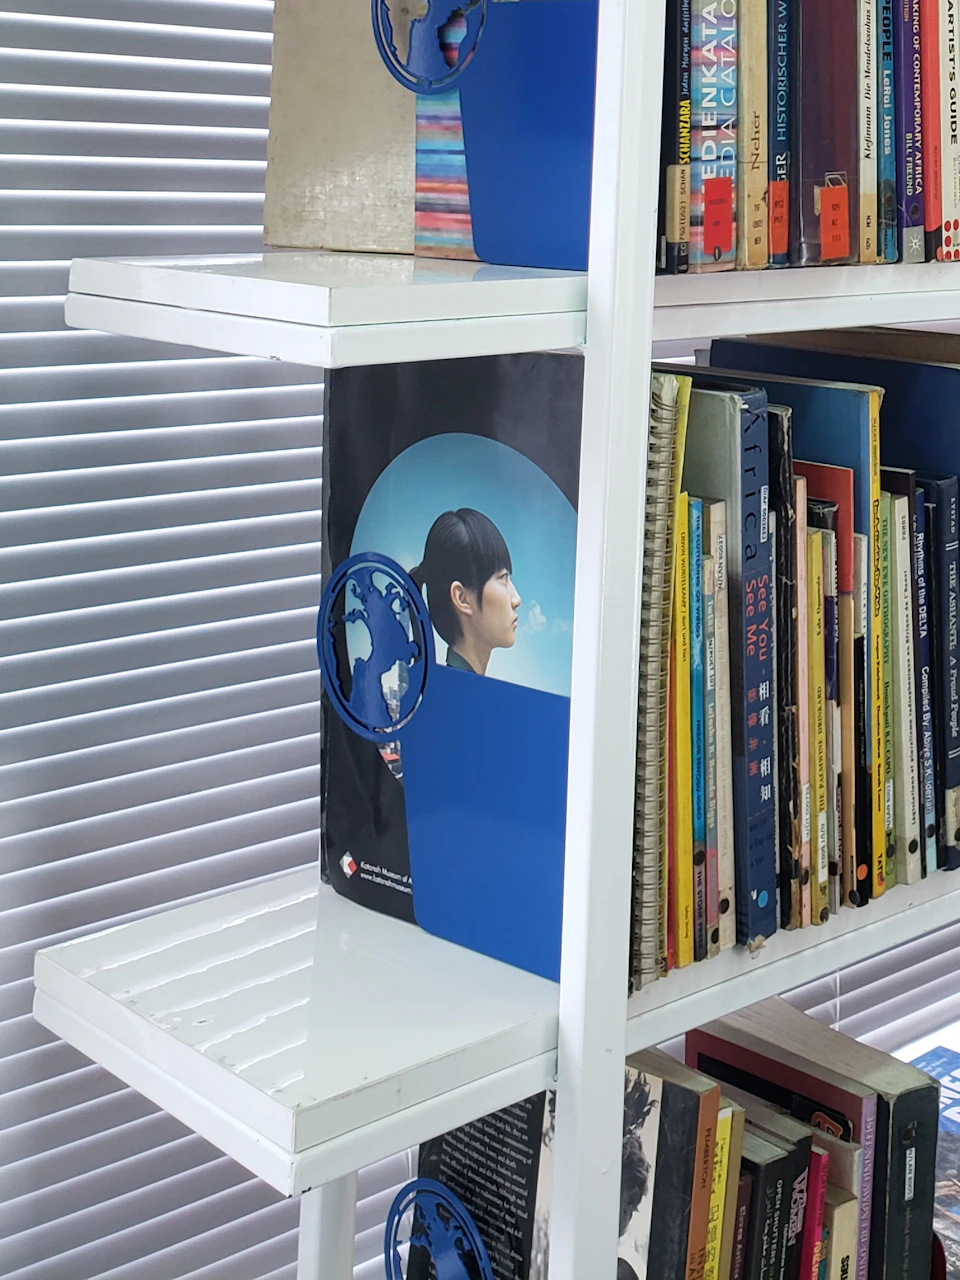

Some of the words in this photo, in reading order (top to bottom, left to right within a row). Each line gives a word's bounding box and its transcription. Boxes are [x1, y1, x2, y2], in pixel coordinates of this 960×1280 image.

[913, 36, 920, 49] OF
[776, 23, 788, 141] HISTORISCHER
[884, 69, 892, 108] LeRoi
[883, 113, 892, 156] Jones
[949, 87, 957, 146] GUIDE
[744, 407, 765, 562] Africa
[916, 532, 925, 574] Rhythms
[746, 577, 756, 617] See
[758, 575, 768, 612] See
[918, 577, 926, 587] of
[918, 589, 926, 605] the
[746, 624, 756, 656] Me
[759, 618, 769, 661] You
[918, 606, 927, 638] DELTA
[921, 666, 931, 711] Compiled
[923, 731, 932, 757] Abiye
[924, 759, 932, 778] S.K.
[360, 861, 381, 873] Katonah
[382, 867, 401, 879] Museum
[701, 1128, 711, 1189] PEMBERTON
[774, 1211, 782, 1264] SHUTTERS
